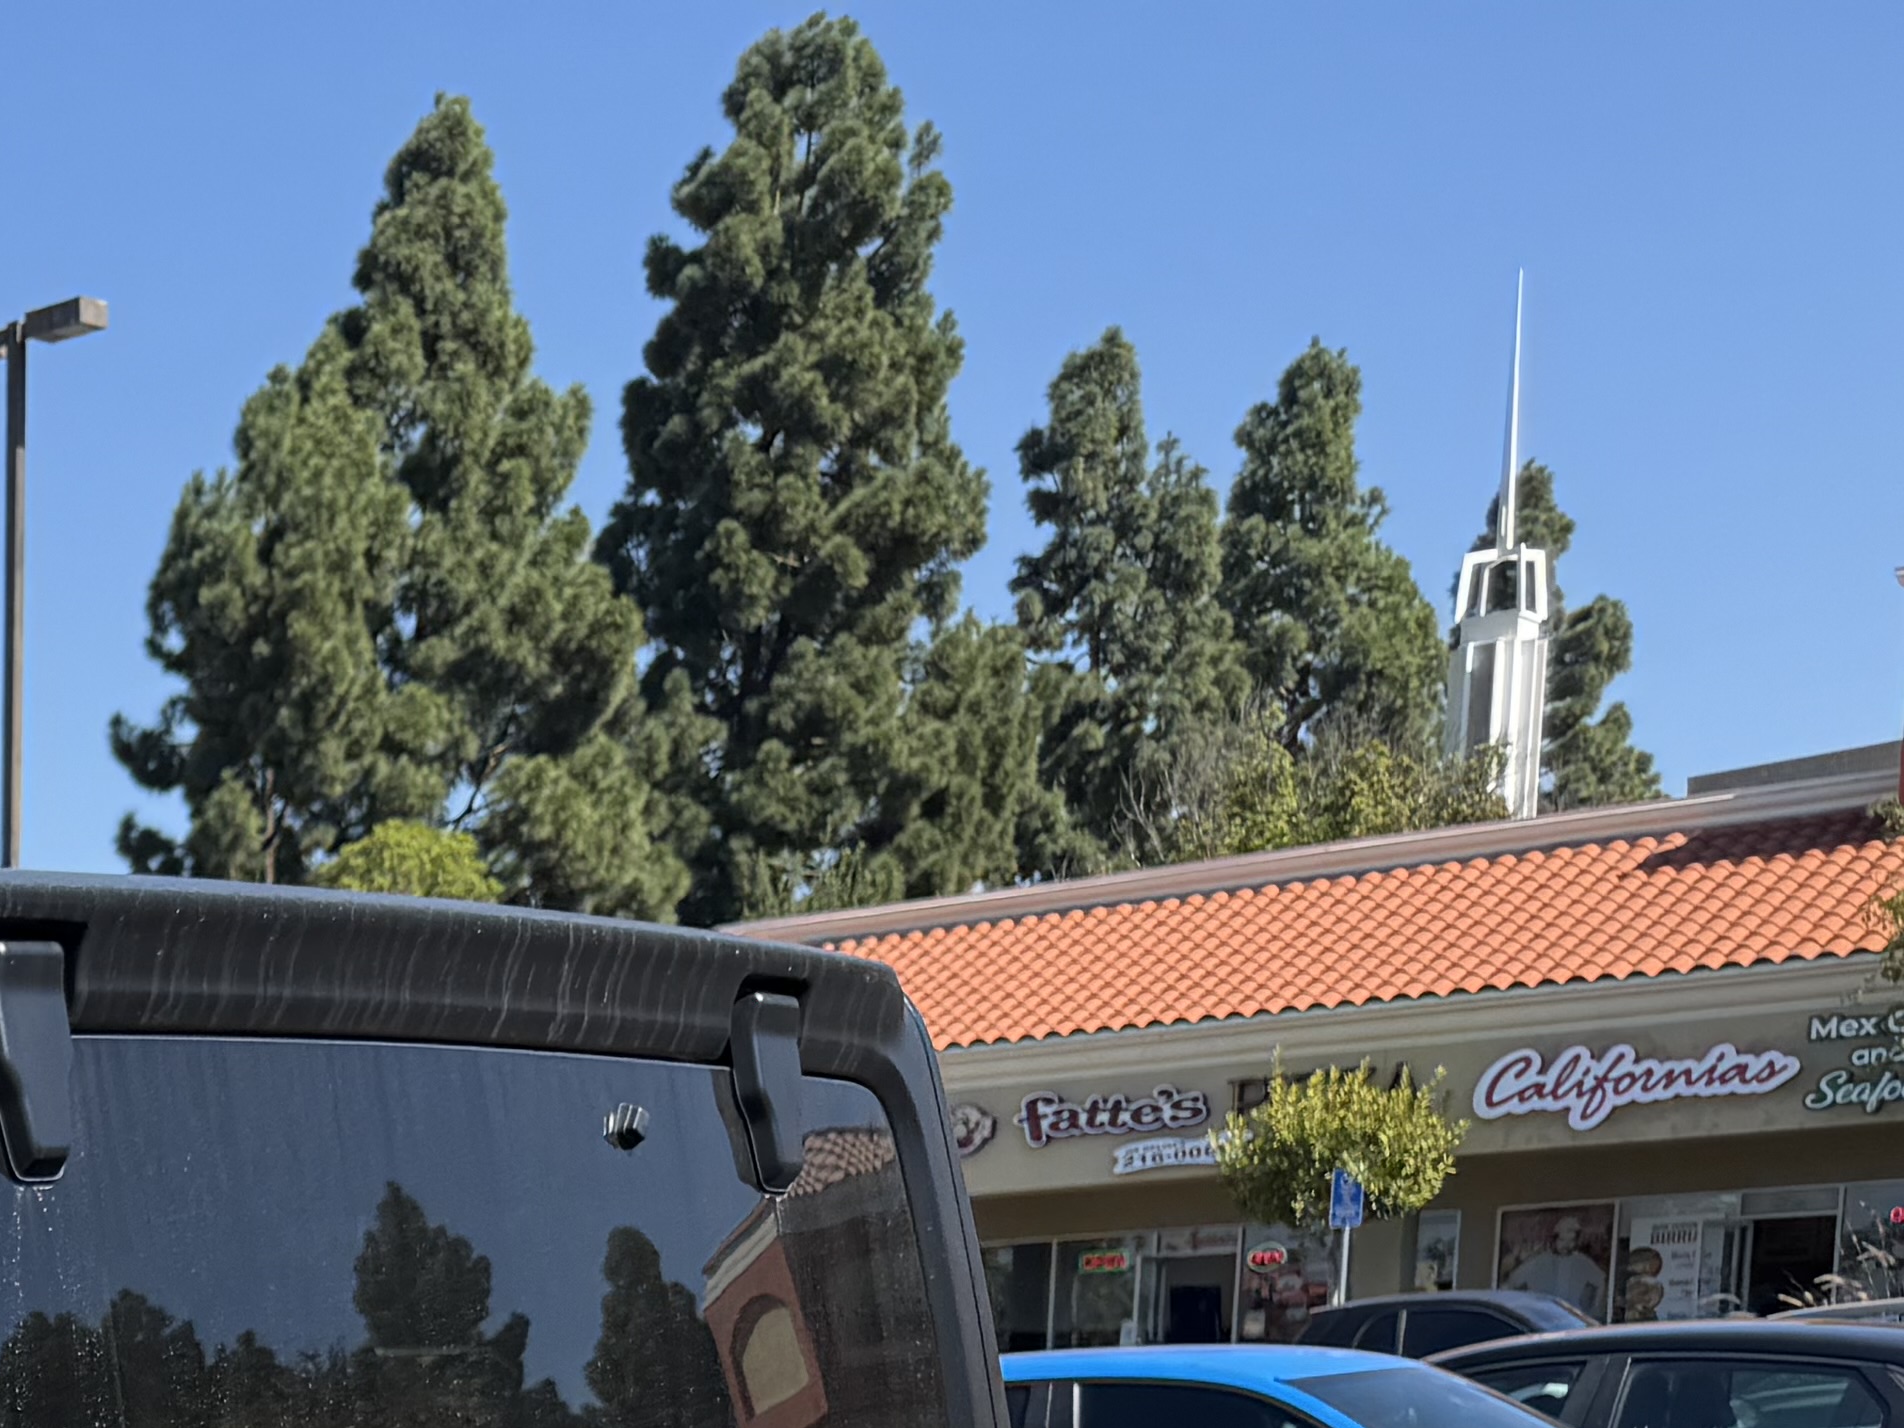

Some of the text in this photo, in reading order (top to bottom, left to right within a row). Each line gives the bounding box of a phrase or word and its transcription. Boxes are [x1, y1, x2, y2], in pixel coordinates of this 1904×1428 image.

[1810, 1015, 1879, 1040] Mex
[1484, 1050, 1789, 1122] Californias
[1804, 1069, 1904, 1113] Seafo
